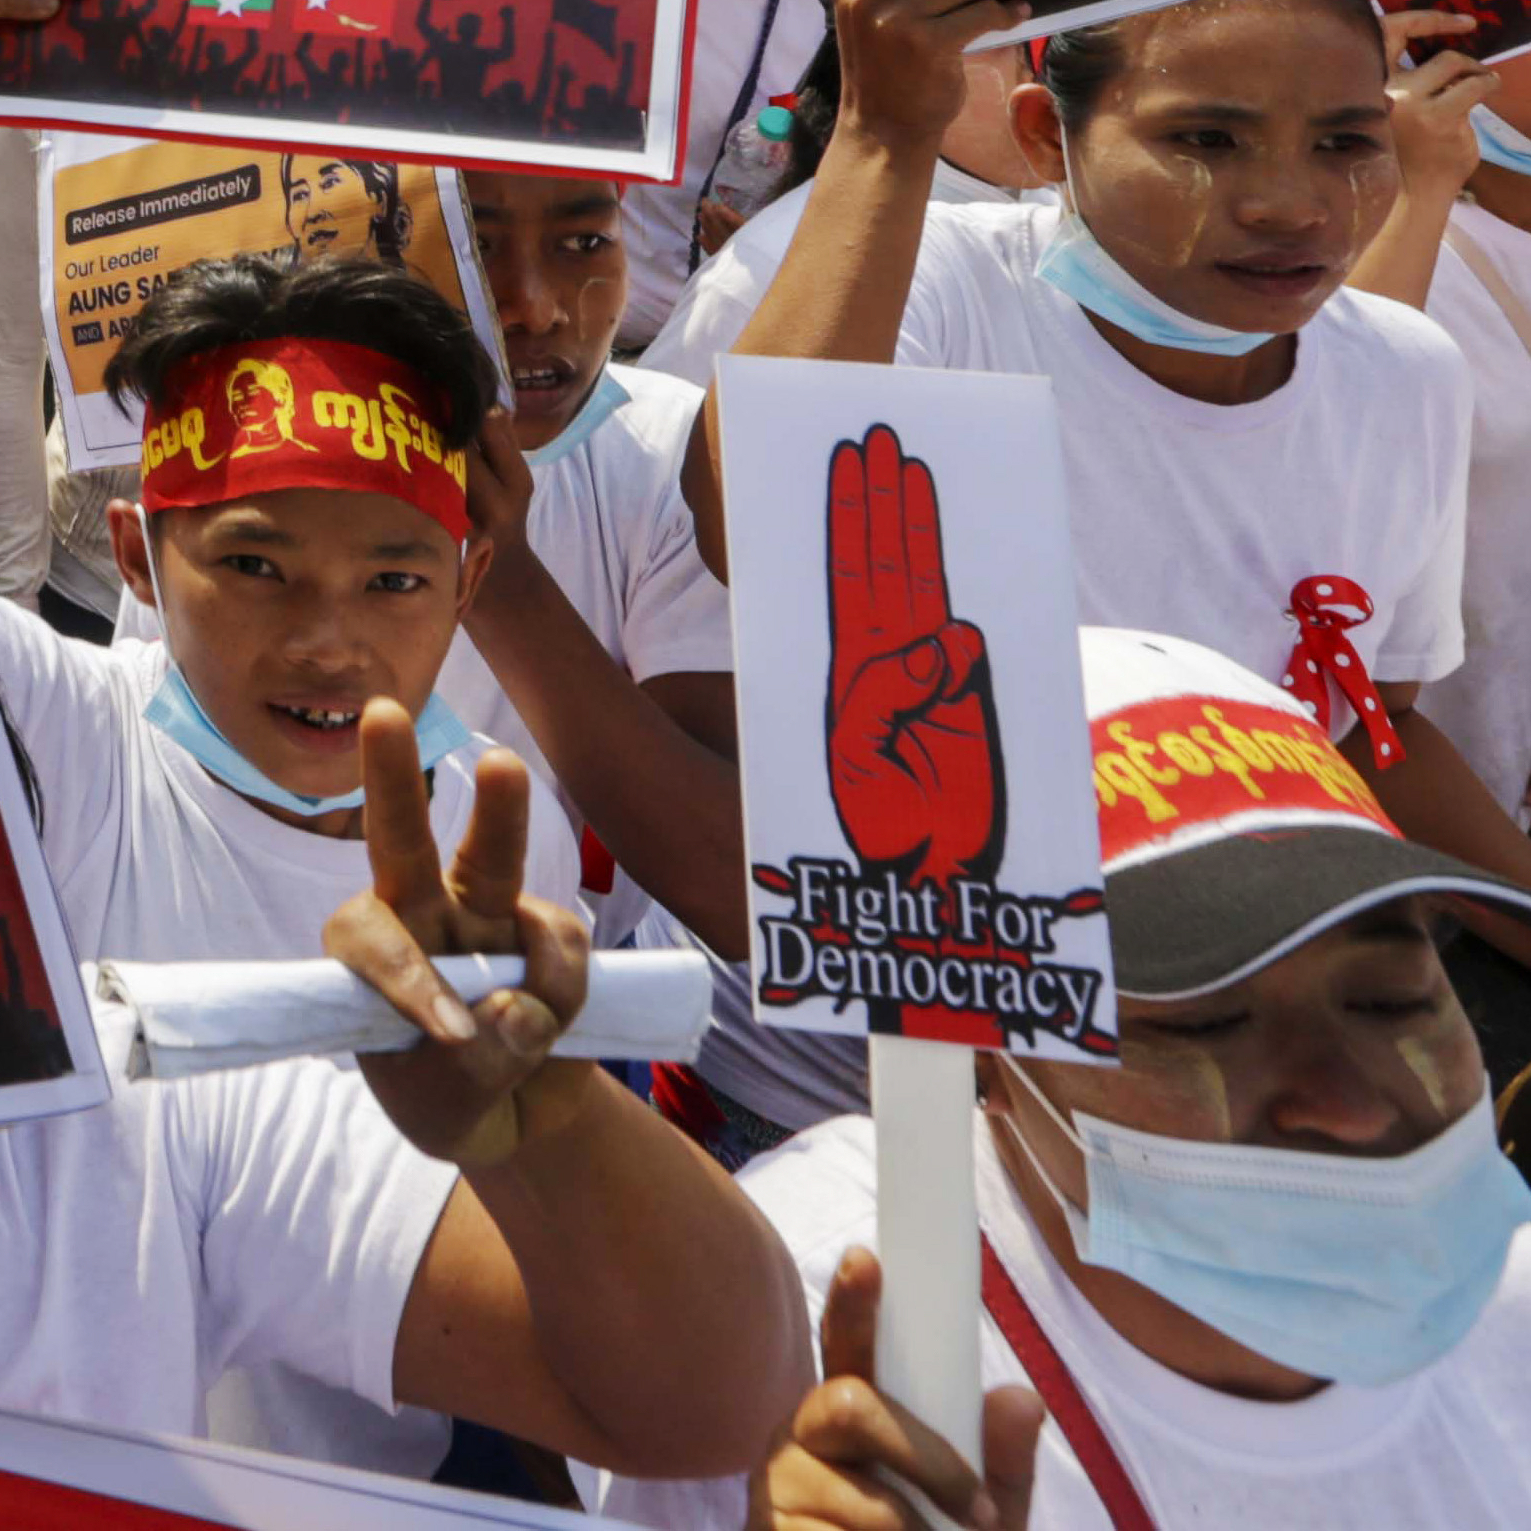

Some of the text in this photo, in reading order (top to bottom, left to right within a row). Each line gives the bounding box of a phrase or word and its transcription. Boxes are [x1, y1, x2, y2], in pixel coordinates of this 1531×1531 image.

[71, 173, 252, 236] Release Immediately
[65, 244, 161, 281] Our Leader
[68, 281, 133, 316] AUNG
[74, 326, 101, 344] AND
[793, 859, 1056, 957] Fight For
[764, 918, 1101, 1028] Democracy
